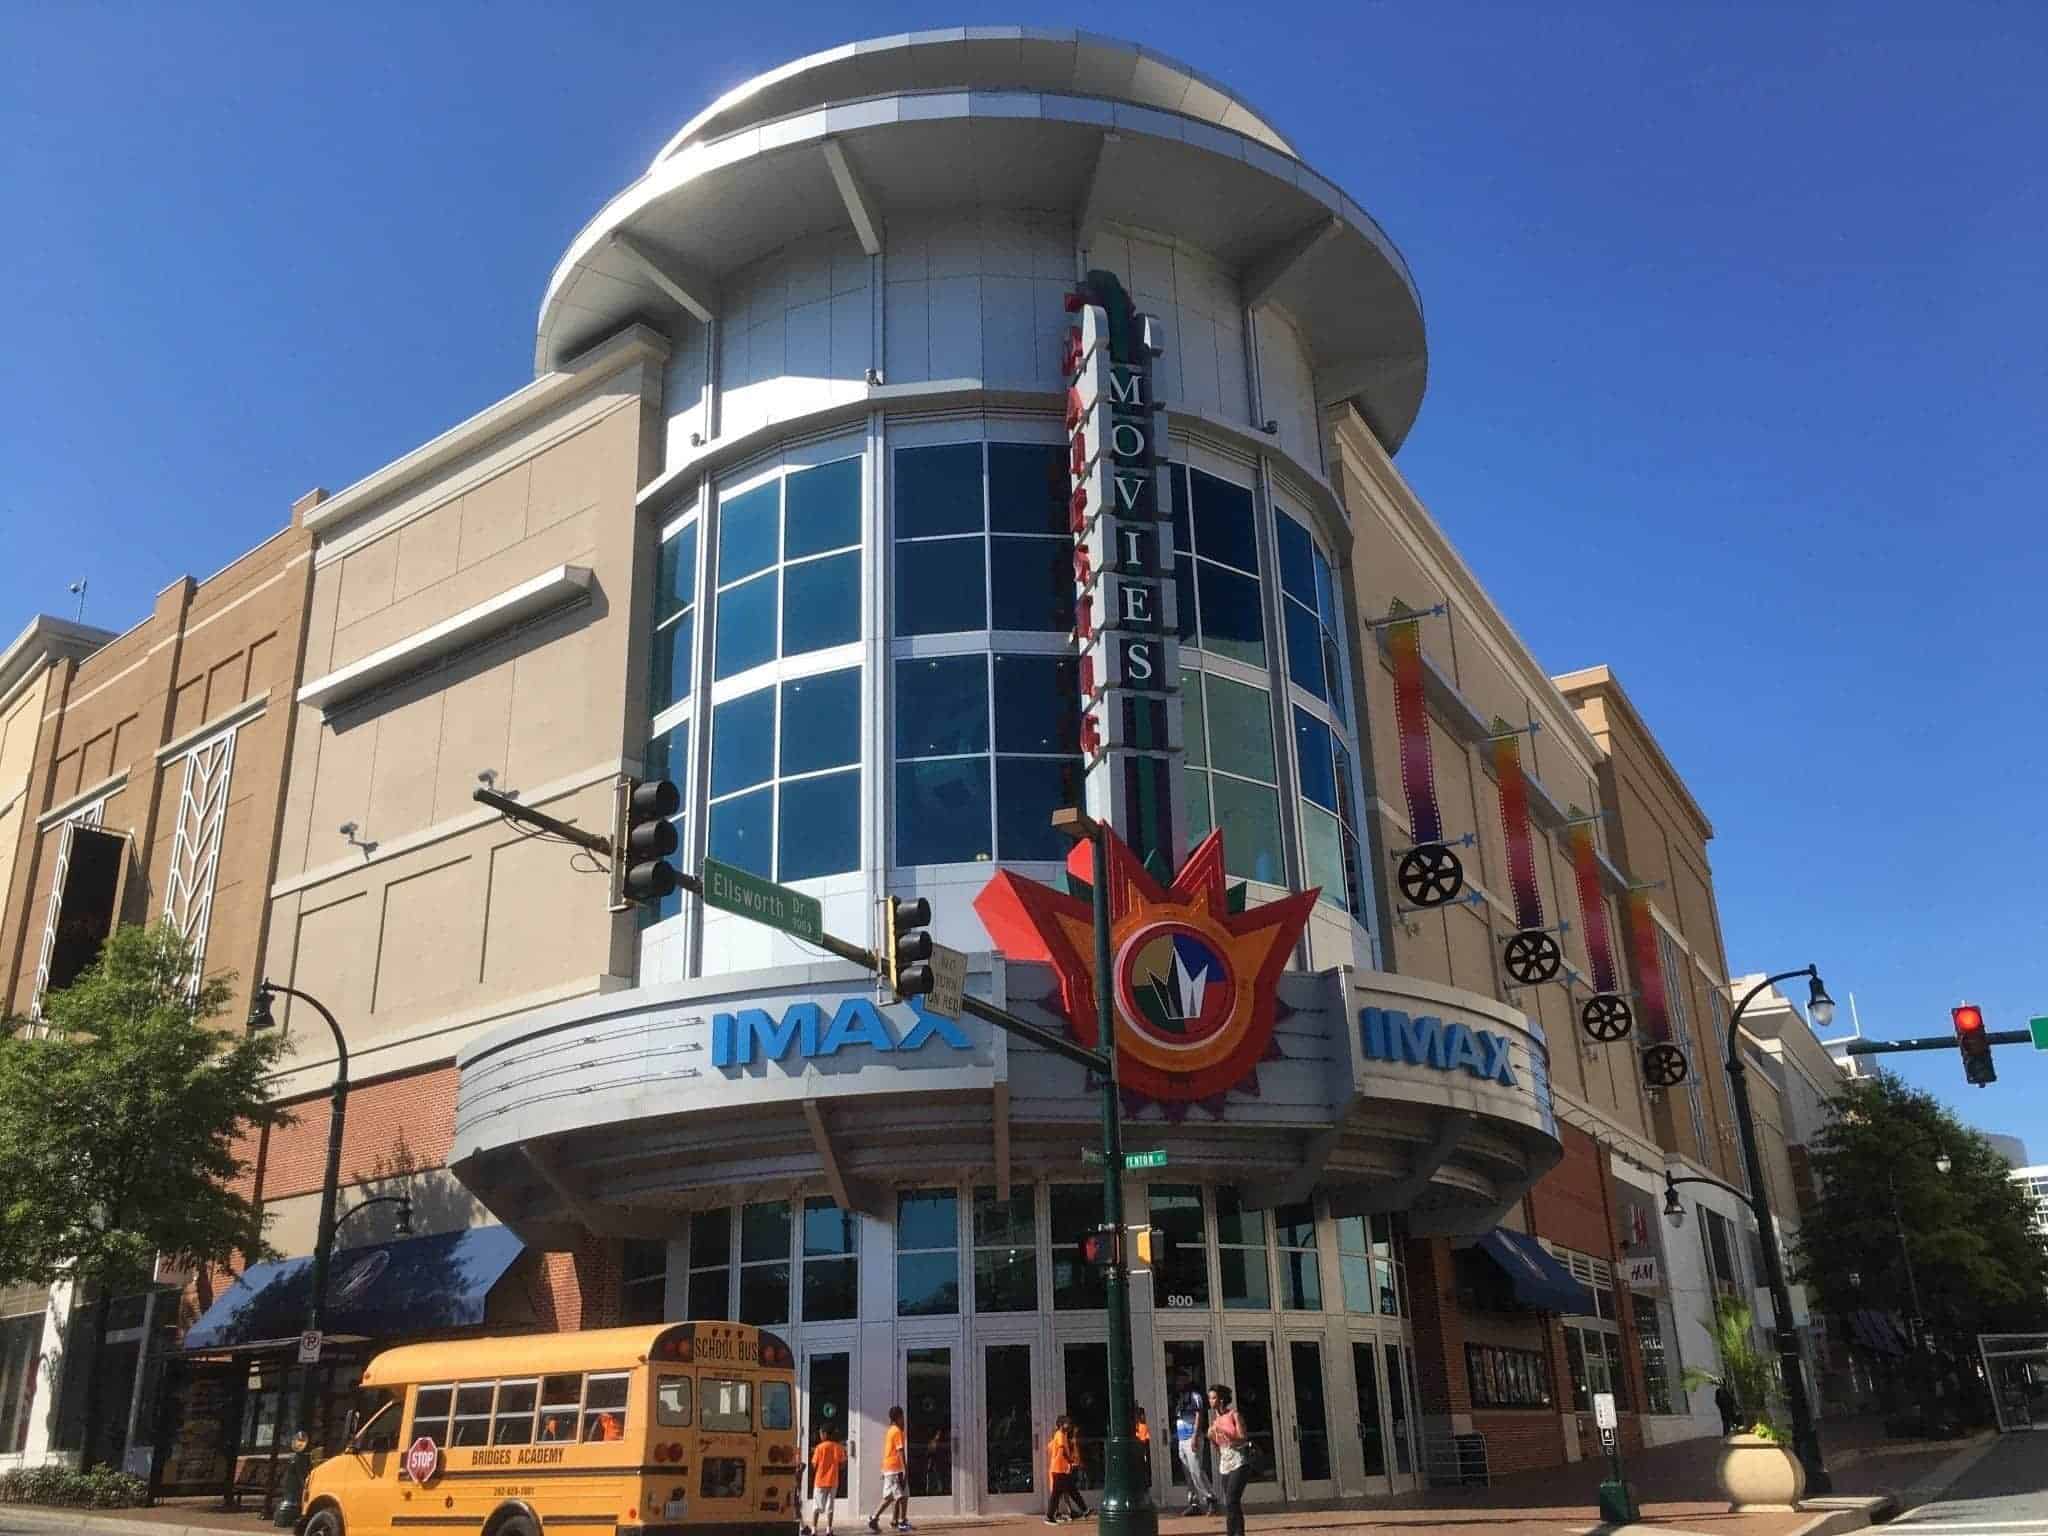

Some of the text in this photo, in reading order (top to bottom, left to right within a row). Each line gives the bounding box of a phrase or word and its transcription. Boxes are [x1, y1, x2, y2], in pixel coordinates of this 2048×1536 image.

[1107, 372, 1152, 679] MOVIES
[713, 872, 785, 919] Ellsworth
[712, 993, 973, 1067] IMAX
[1360, 1006, 1518, 1086] IMAX
[1167, 1295, 1193, 1307] 900
[695, 1337, 760, 1361] SCHOOL BUS
[411, 1451, 434, 1468] STOP
[472, 1447, 565, 1466] BRIDGES ACADEMY
